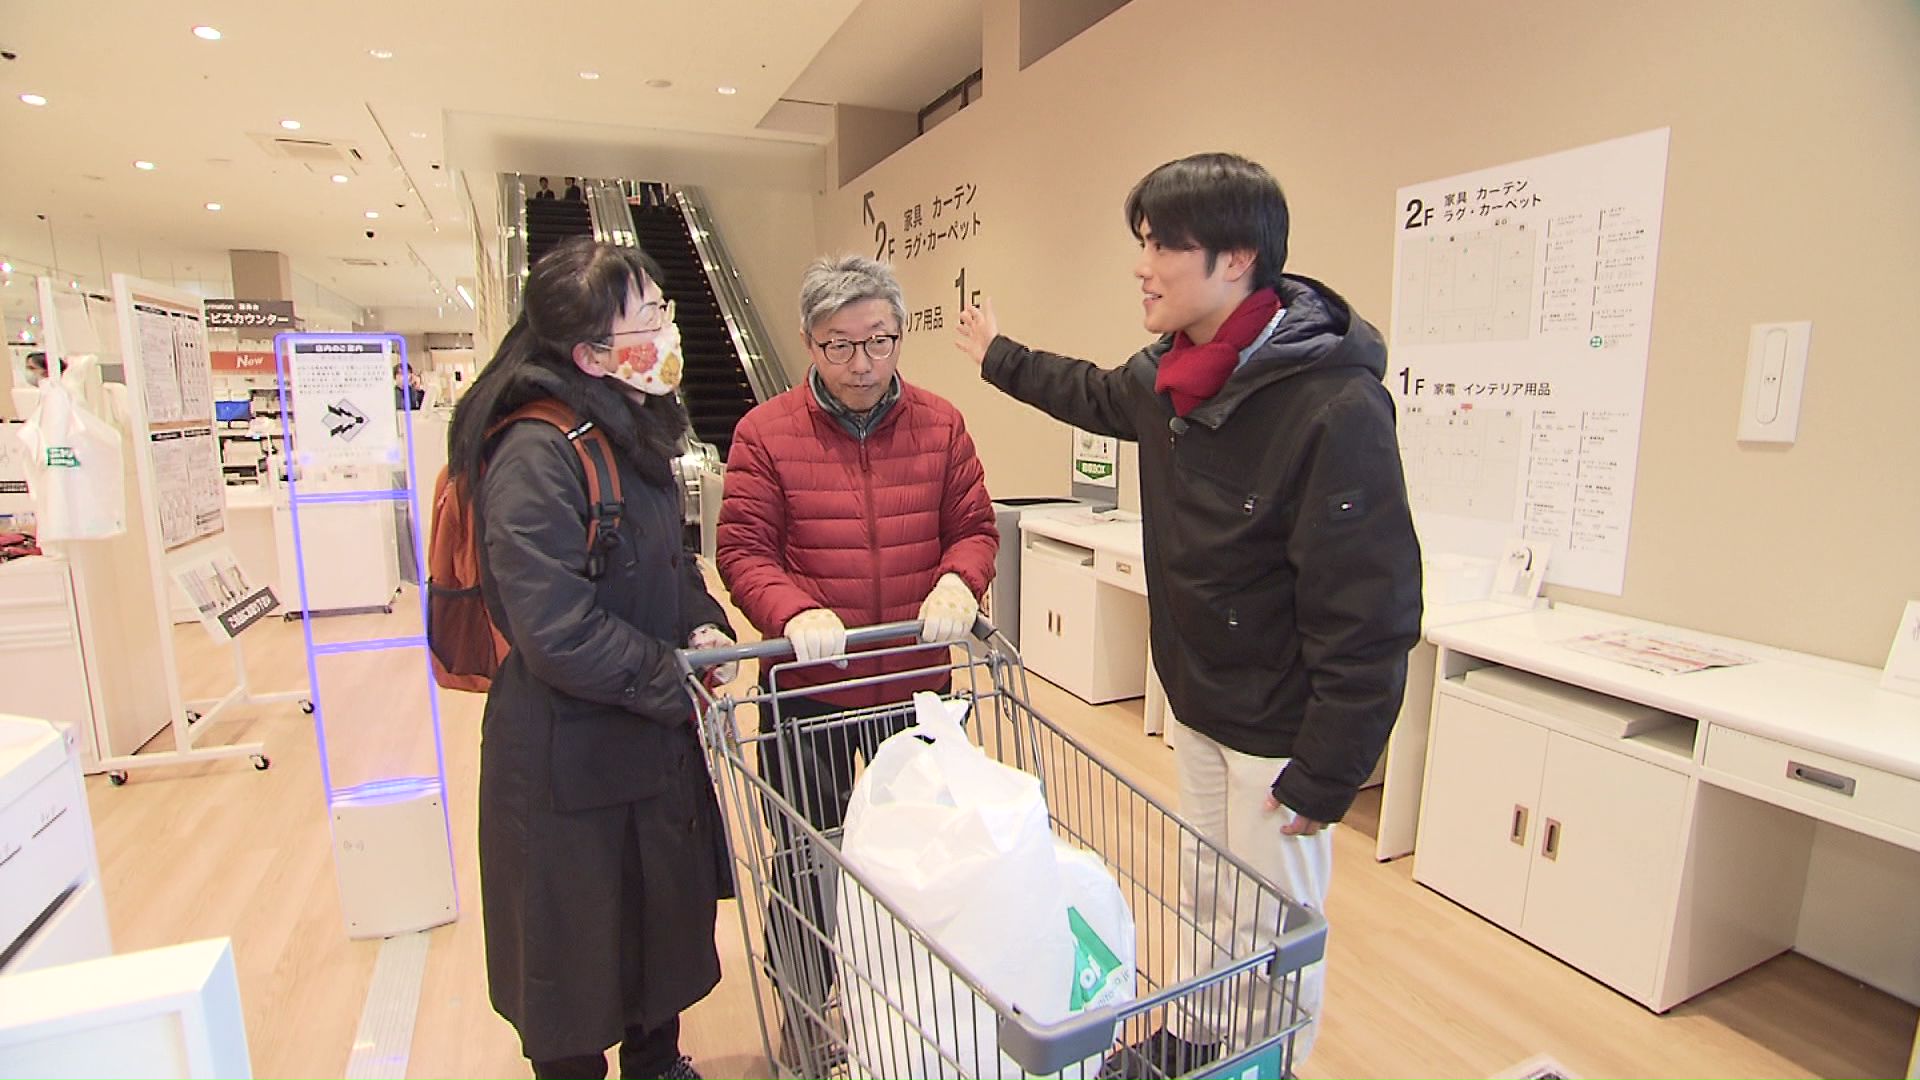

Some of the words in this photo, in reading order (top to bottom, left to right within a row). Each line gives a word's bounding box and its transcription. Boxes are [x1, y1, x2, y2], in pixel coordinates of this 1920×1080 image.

[903, 204, 922, 232] 家具
[932, 183, 977, 220] カーテン
[1444, 191, 1467, 206] 家具
[1477, 180, 1528, 200] カーテン
[1444, 193, 1542, 222] ラグ・カーペット
[1404, 198, 1434, 229] 2F
[875, 220, 895, 263] 2F
[904, 211, 981, 260] ラグ・カーペット
[236, 354, 264, 368] New
[1399, 366, 1425, 396] 1F
[1433, 382, 1456, 396] 家電
[1463, 382, 1551, 396] インテリア用品
